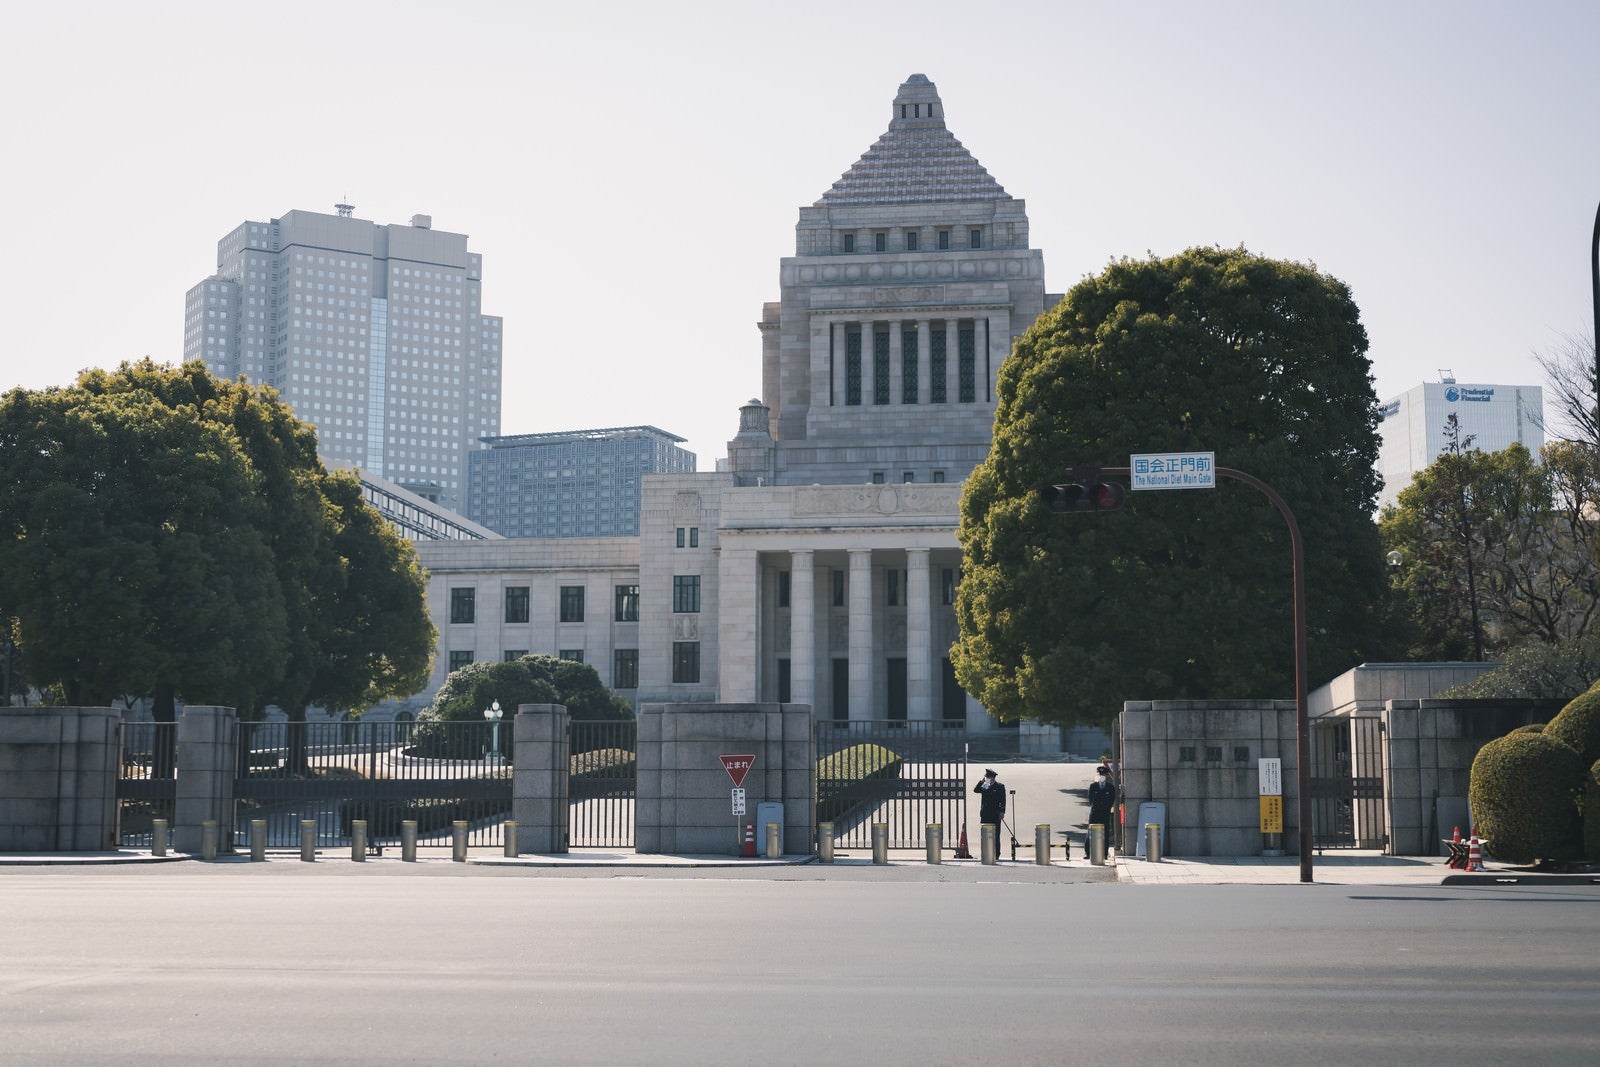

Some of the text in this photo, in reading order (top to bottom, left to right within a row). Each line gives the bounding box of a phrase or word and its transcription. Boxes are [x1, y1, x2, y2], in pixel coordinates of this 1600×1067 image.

[1136, 457, 1210, 473] 国会正門前
[1135, 473, 1212, 485] The National Diet Main Gate
[727, 761, 748, 769] 止まれ
